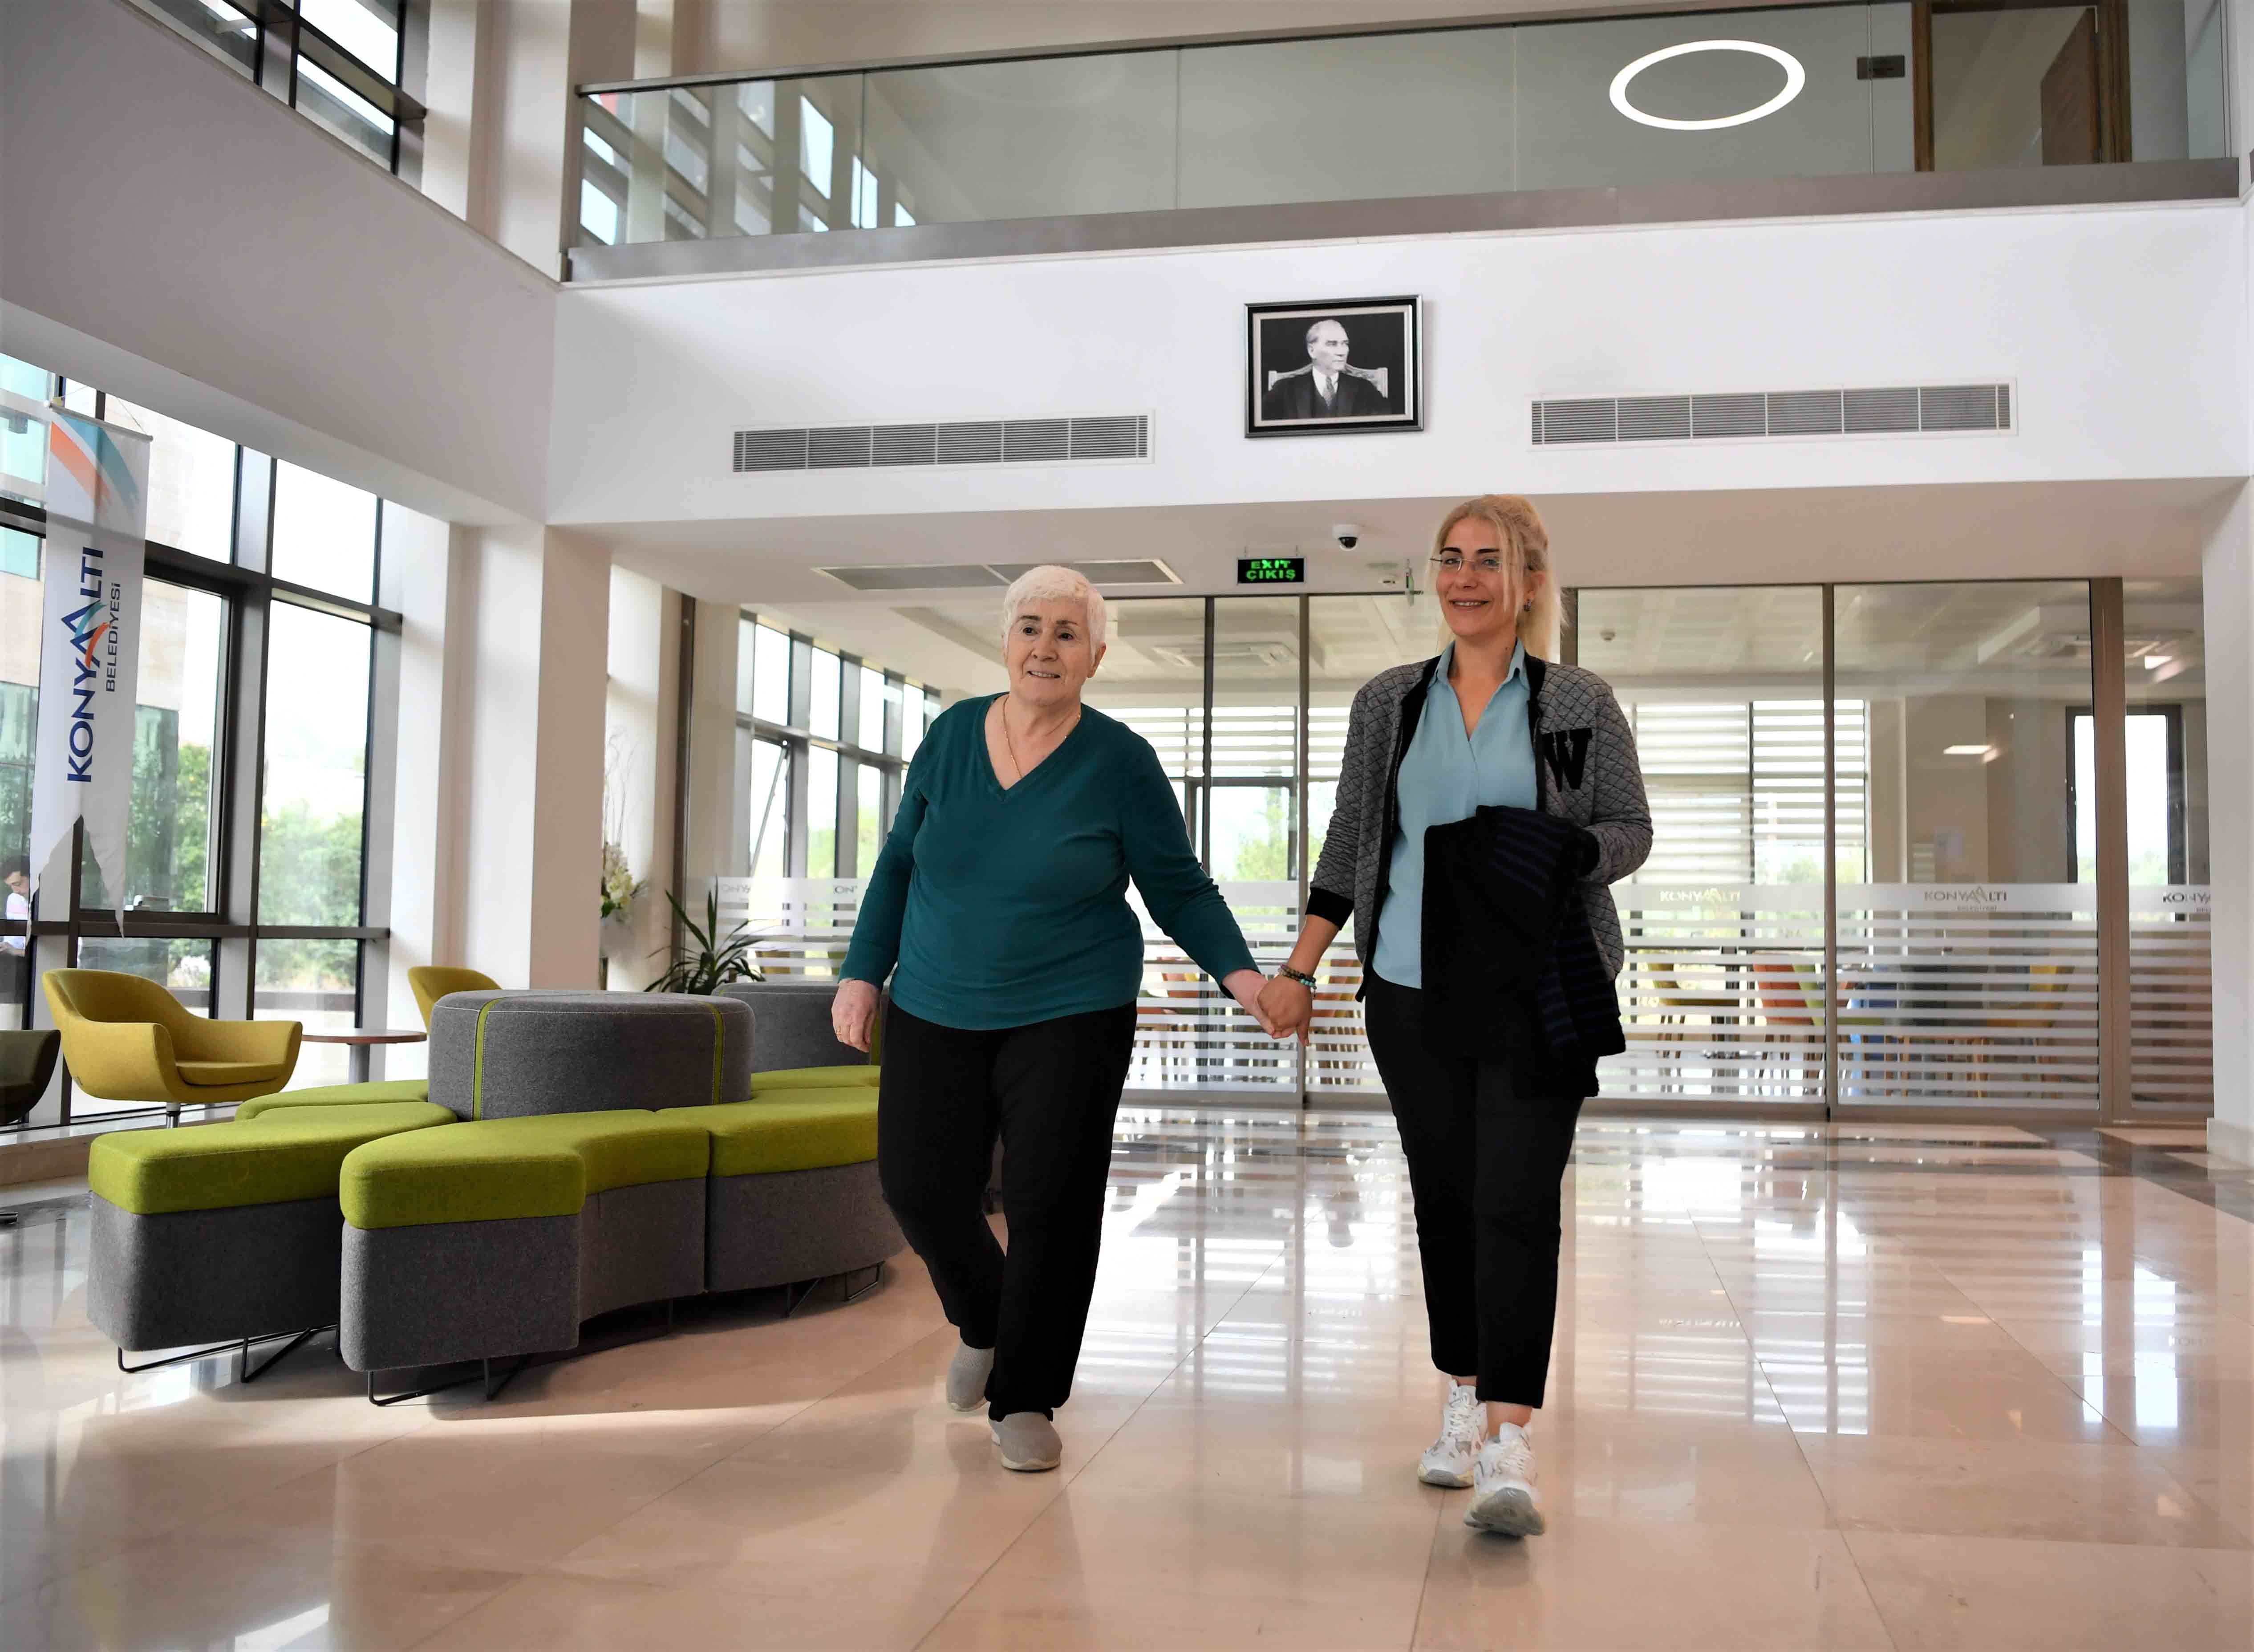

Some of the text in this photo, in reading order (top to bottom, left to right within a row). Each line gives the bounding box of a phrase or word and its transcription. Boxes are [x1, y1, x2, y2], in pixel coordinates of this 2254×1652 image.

[1251, 560, 1290, 569] EXIT
[61, 547, 103, 782] KONYAALTI
[1542, 728, 1592, 792] W
